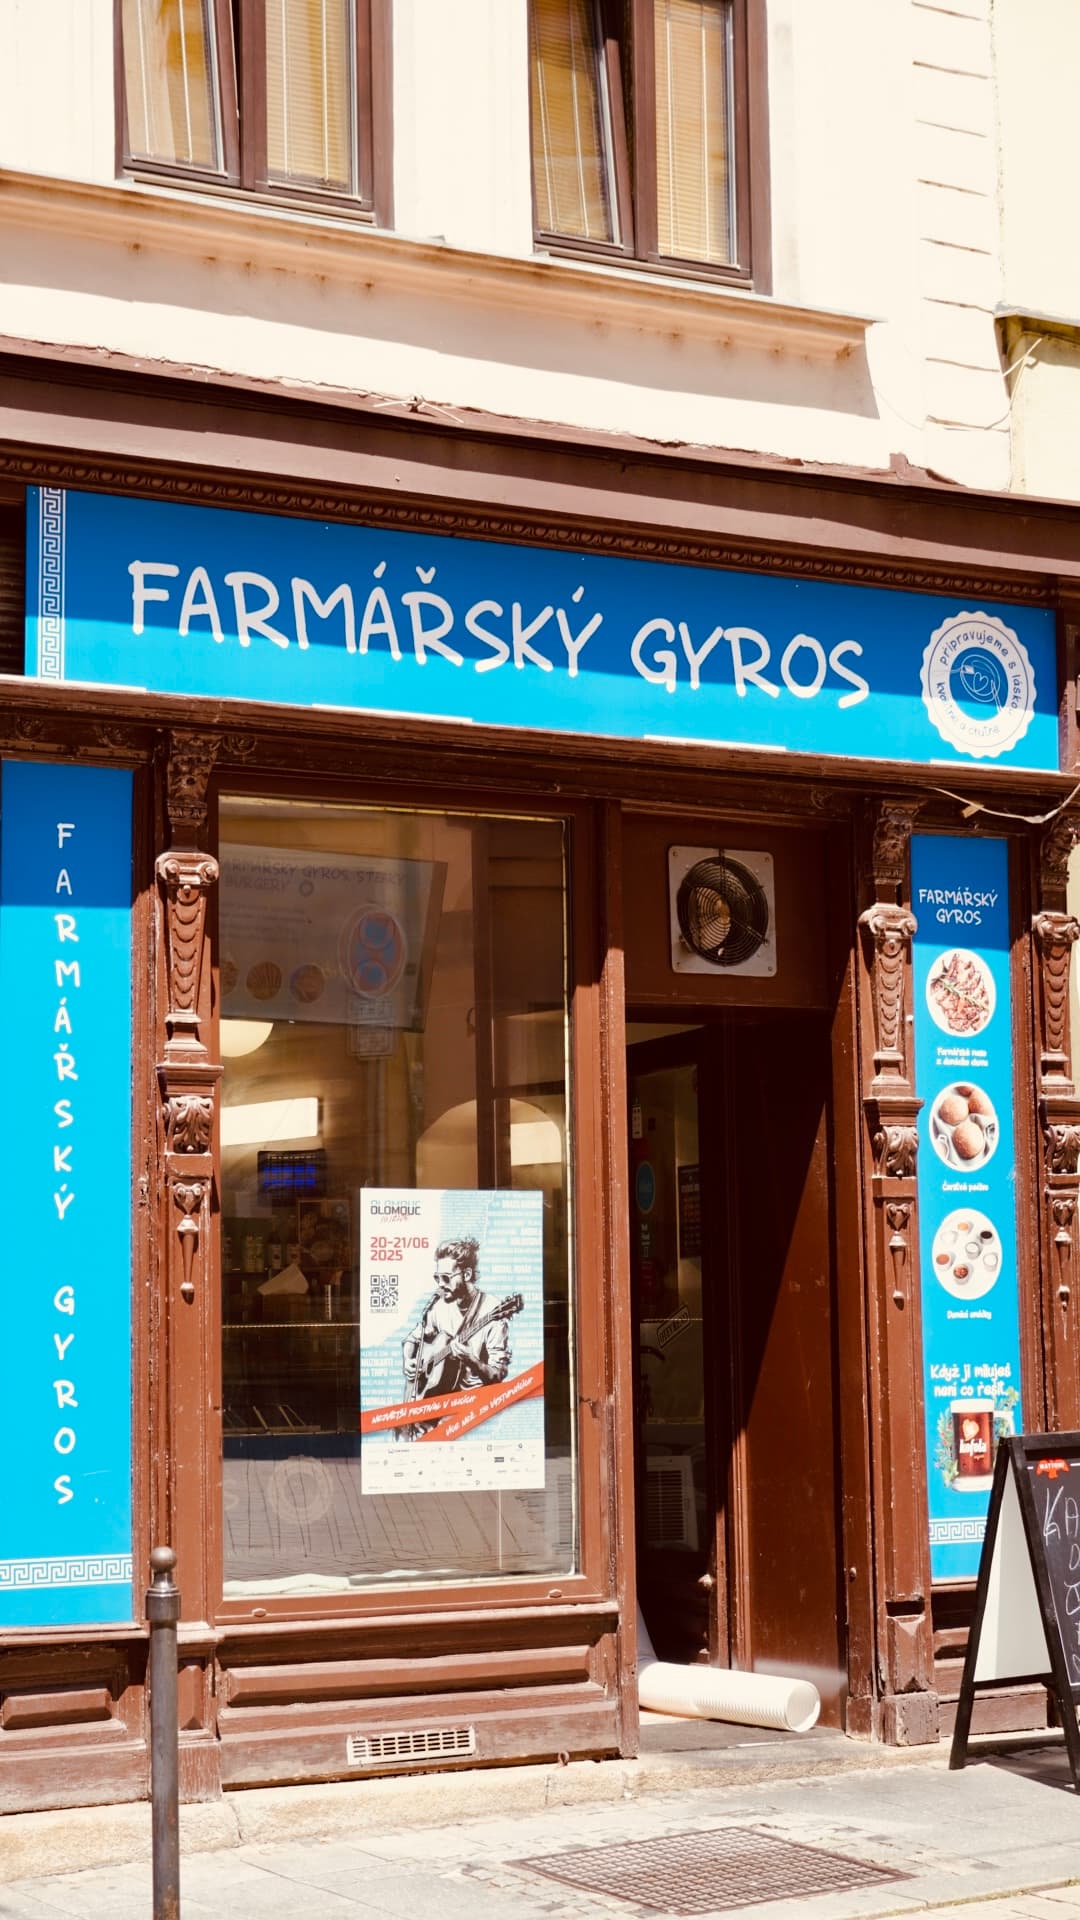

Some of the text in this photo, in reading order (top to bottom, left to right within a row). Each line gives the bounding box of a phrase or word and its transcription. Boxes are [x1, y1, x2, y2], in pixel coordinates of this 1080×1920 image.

[128, 559, 870, 709] FARMÁŘSKÝ GYROS
[918, 886, 999, 908] FARMÁŘSKÝ
[935, 909, 983, 926] GYROS
[52, 823, 81, 1506] FARMÁŘSKÝ GYROS
[370, 1204, 422, 1216] OLOMOUC
[370, 1236, 430, 1249] 20-21/06
[370, 1249, 404, 1262] 2025
[929, 1363, 961, 1382] Když
[961, 1363, 971, 1383] ji
[934, 1380, 958, 1398] není
[960, 1384, 974, 1397] co
[443, 1399, 450, 1409] V
